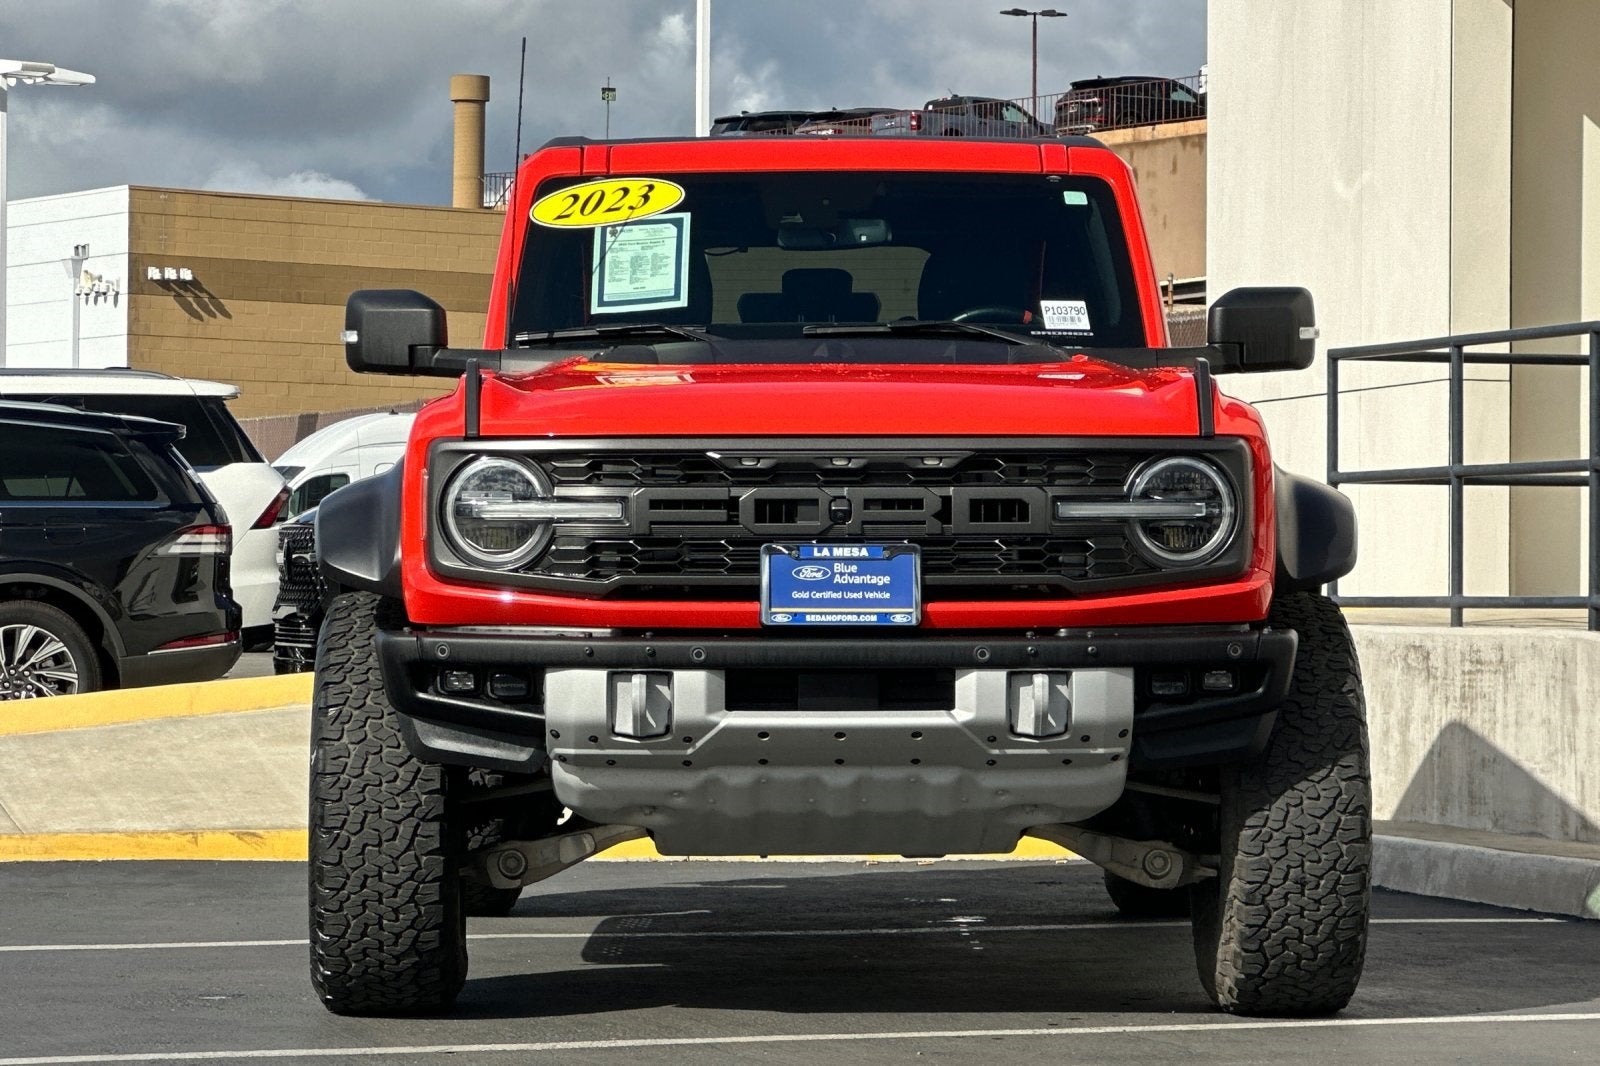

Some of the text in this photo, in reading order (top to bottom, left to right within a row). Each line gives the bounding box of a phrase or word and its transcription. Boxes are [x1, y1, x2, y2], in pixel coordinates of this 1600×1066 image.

[553, 183, 655, 221] 2023
[1044, 306, 1086, 316] P103790
[632, 486, 1049, 536] FORD
[813, 547, 869, 557] LA MESA
[799, 567, 824, 578] Ford
[833, 563, 858, 573] Blue
[833, 574, 891, 585] Advantage
[792, 591, 891, 599] Gold Certified Used Vehicle
[805, 614, 878, 622] SEDANOFORD.COM
